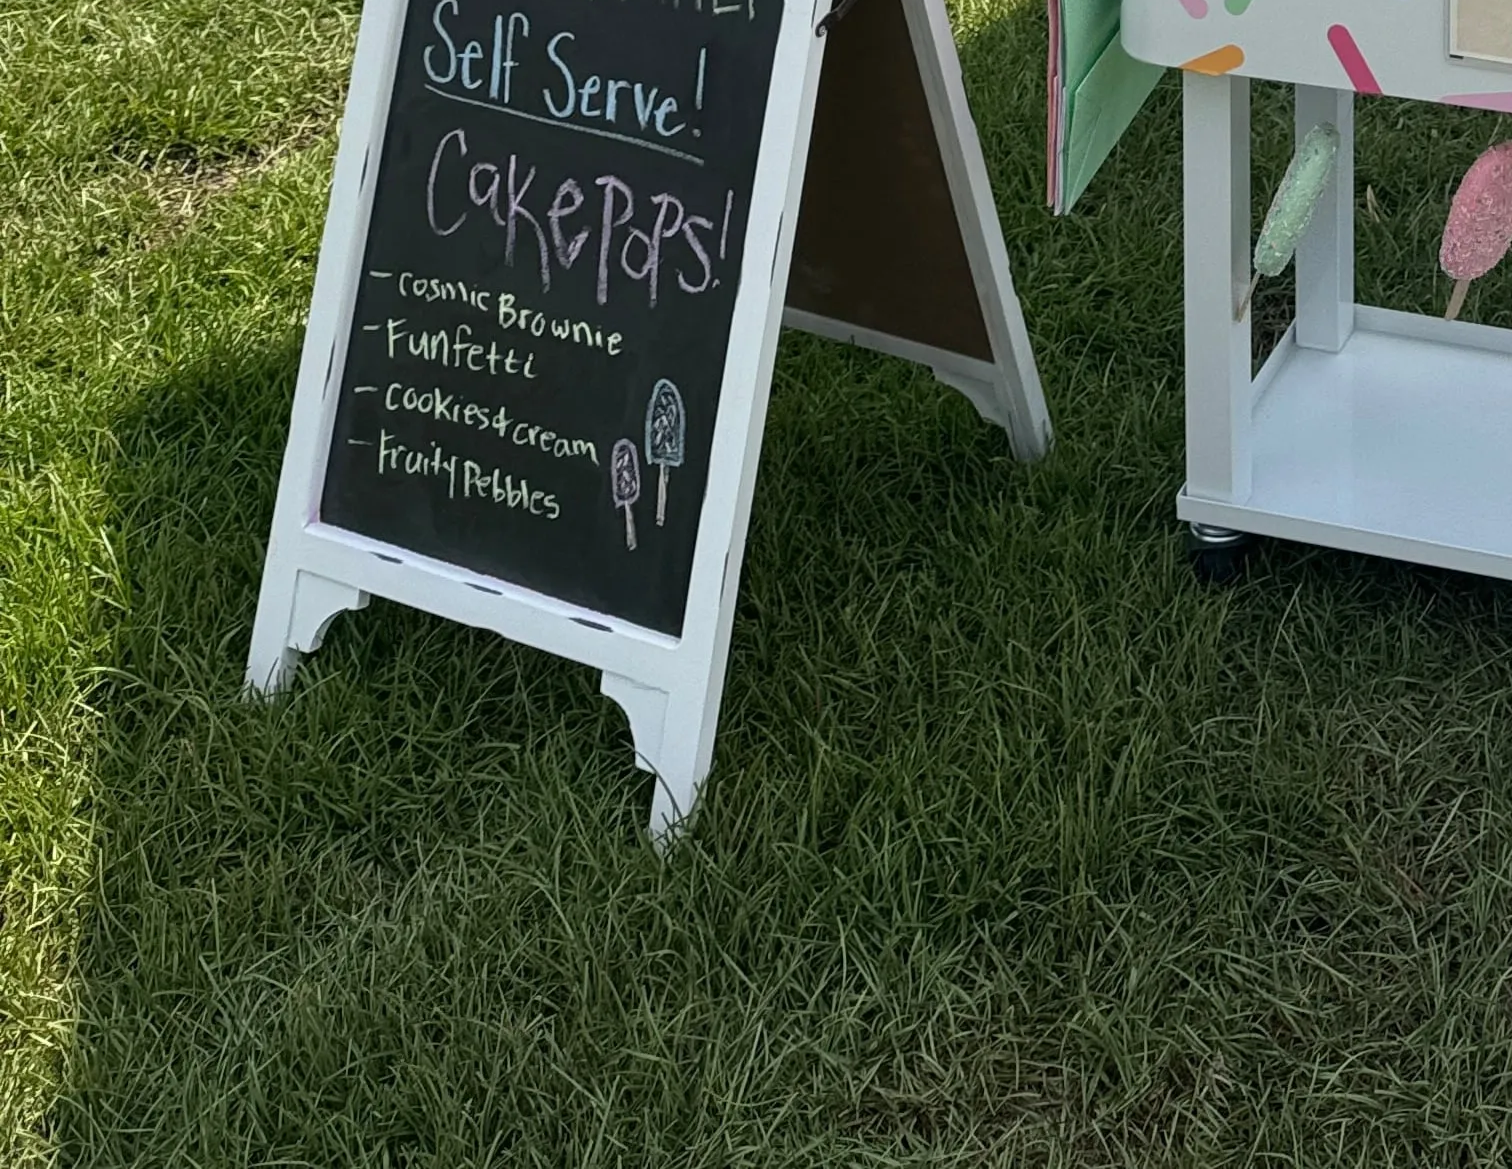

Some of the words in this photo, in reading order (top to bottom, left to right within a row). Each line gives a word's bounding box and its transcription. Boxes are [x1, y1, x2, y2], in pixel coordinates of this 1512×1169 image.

[541, 31, 707, 139] Serve!
[386, 318, 538, 379] Funfetti
[498, 293, 625, 356] Brownie
